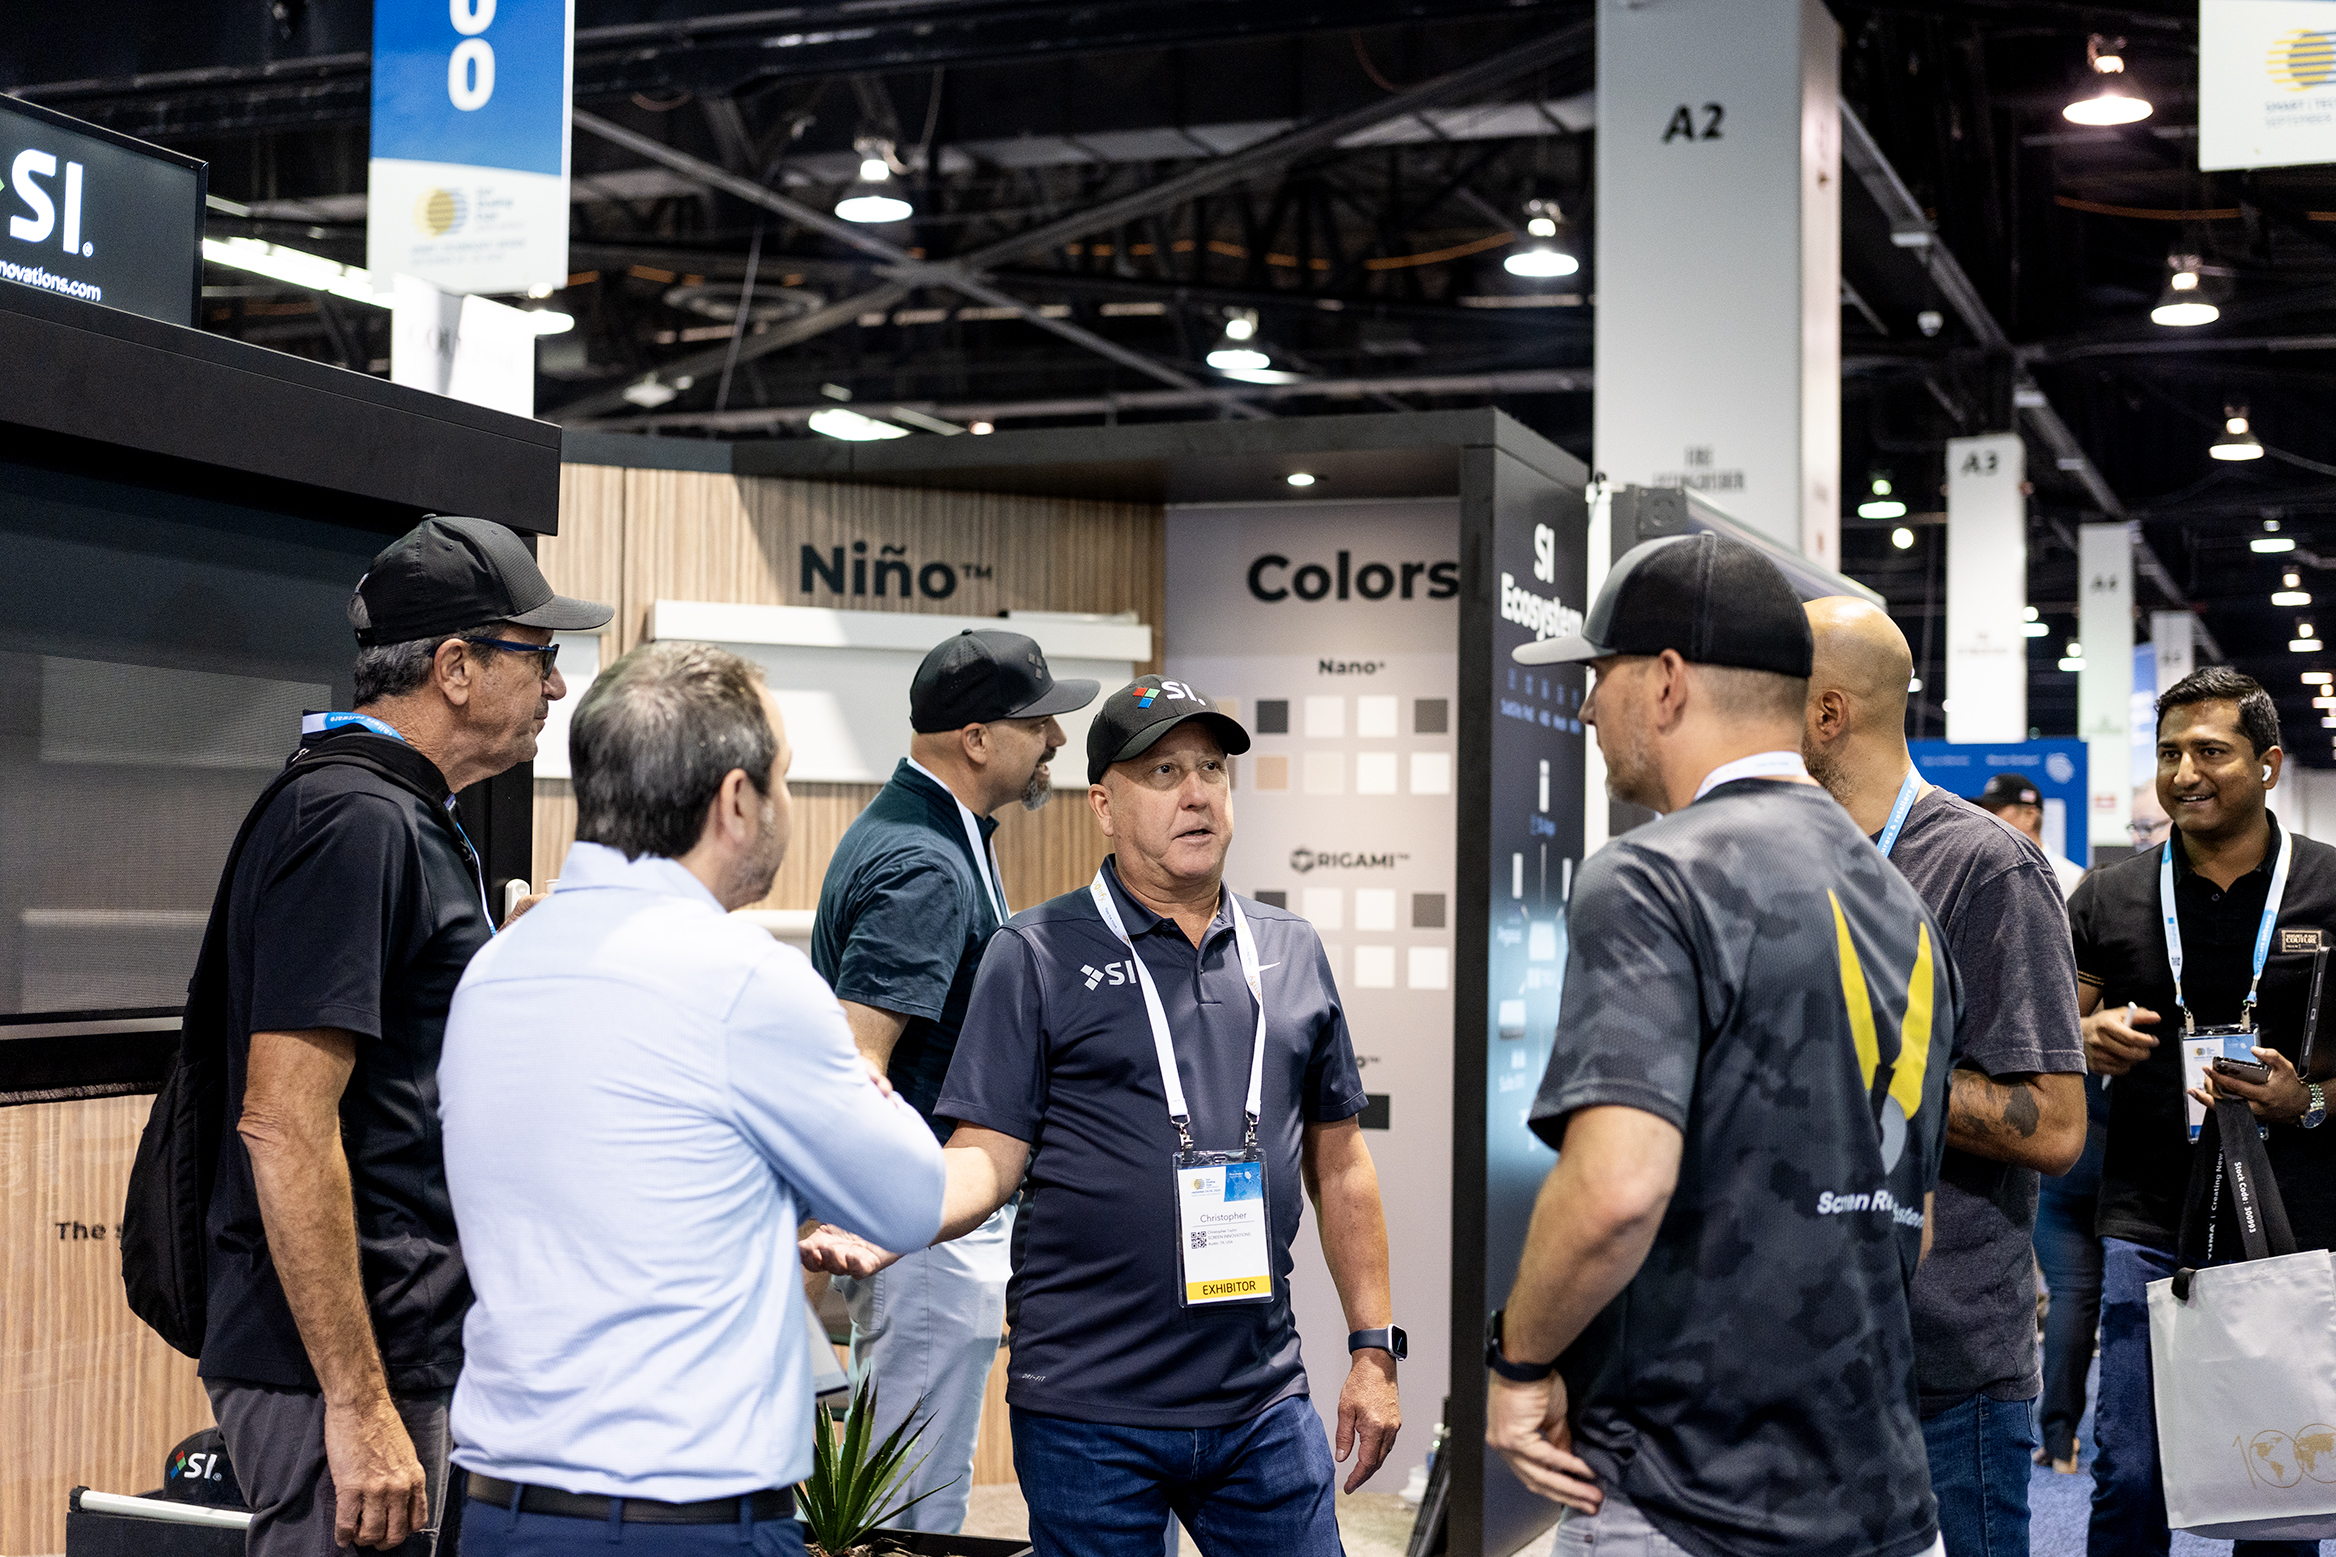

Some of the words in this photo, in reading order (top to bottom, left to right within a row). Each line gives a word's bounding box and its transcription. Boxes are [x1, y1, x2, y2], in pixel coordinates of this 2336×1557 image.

[1661, 103, 1724, 144] A2
[1961, 451, 1999, 478] A3
[1534, 523, 1555, 584] SI
[1247, 550, 1460, 602] Colors
[1501, 571, 1583, 642] Ecosystem
[2215, 1152, 2224, 1173] New
[2234, 1161, 2245, 1182] Stock
[2211, 1173, 2223, 1211] Creating
[2239, 1182, 2250, 1205] Code:
[55, 1221, 107, 1241] The
[1200, 1212, 1248, 1223] Christopher
[2244, 1205, 2257, 1234] 300993
[1202, 1280, 1257, 1296] EXHIBITOR
